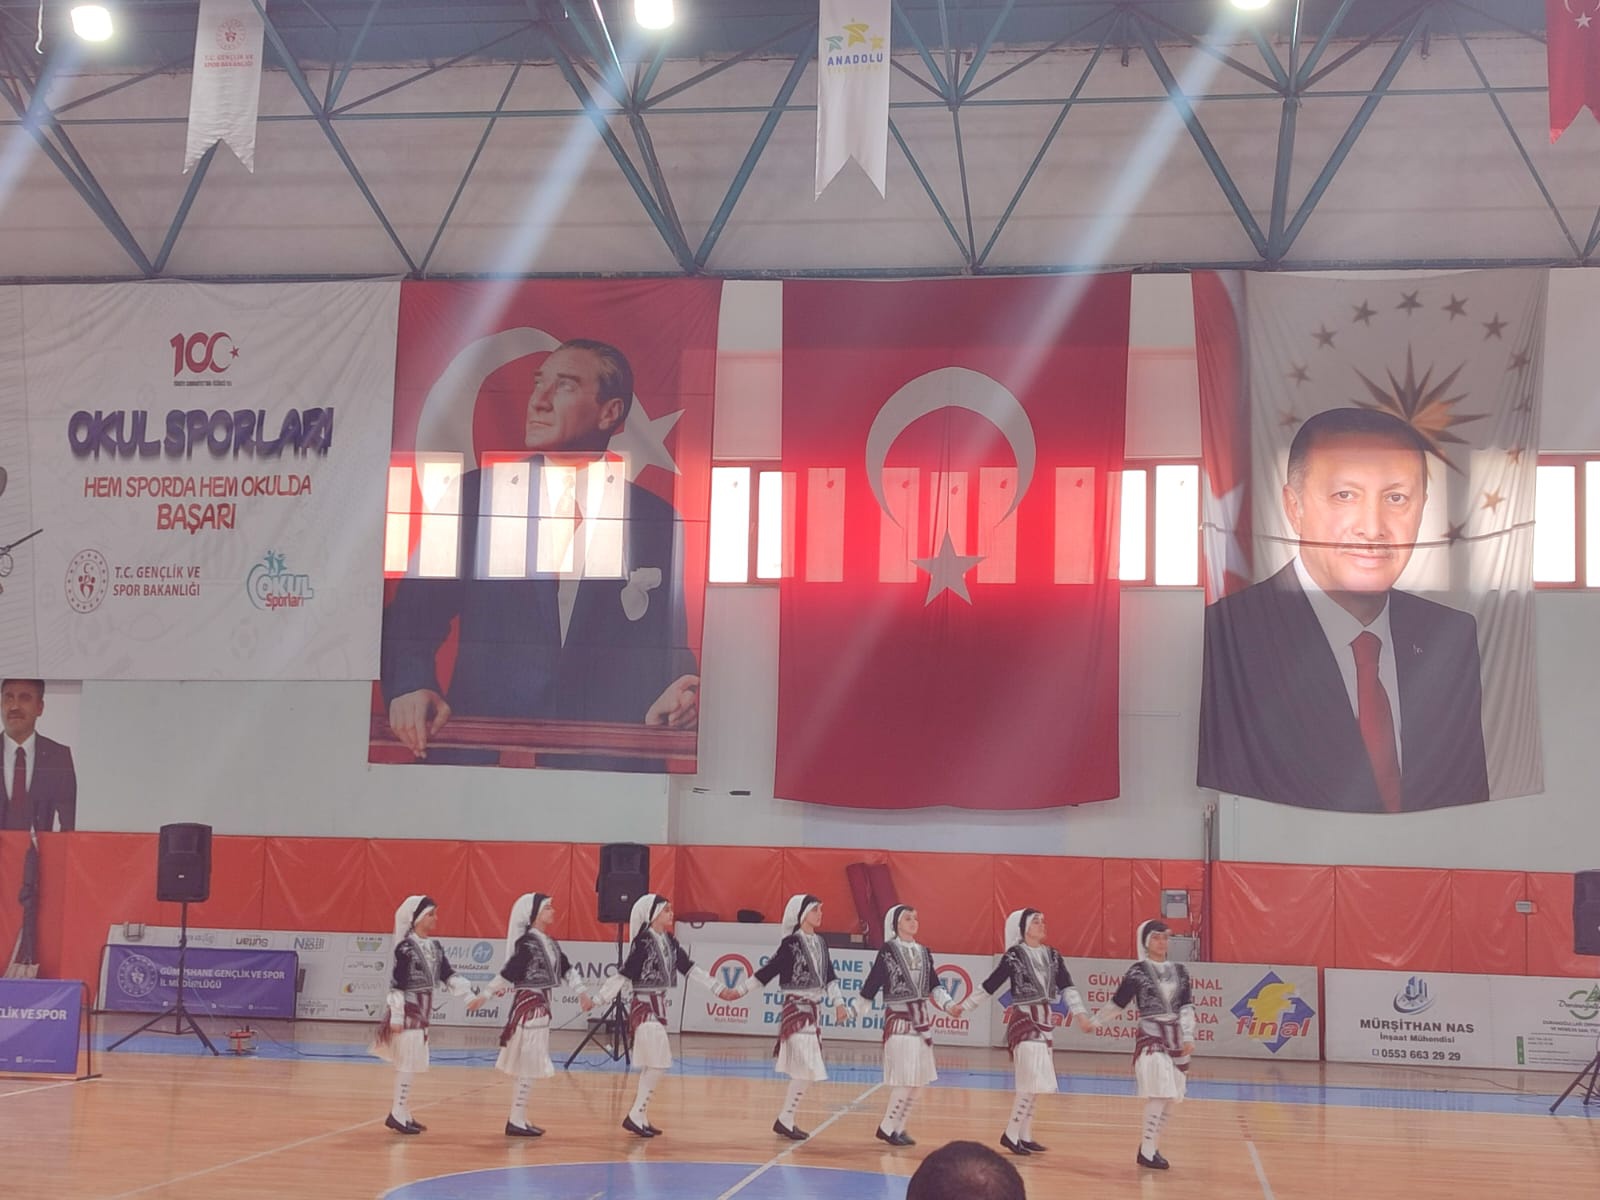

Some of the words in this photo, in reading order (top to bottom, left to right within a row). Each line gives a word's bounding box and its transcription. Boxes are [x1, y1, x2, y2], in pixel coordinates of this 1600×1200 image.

[827, 53, 883, 66] ANADOLU
[68, 410, 161, 459] OKUL
[163, 407, 335, 459] SPORLARI
[84, 477, 122, 498] HEM
[126, 476, 197, 498] SPORDA
[200, 476, 238, 497] HEM
[241, 475, 312, 496] OKULDA
[157, 503, 237, 534] BAŞARI
[115, 566, 134, 579] T.C.
[137, 565, 185, 583] GENÇLİK
[187, 566, 201, 579] VE
[113, 584, 141, 597] SPOR
[144, 581, 201, 597] BAKANLIĞI
[257, 574, 313, 600] OKUL
[214, 969, 250, 981] GENÇLİK
[251, 970, 262, 979] VE
[263, 971, 285, 980] SPOR
[169, 978, 222, 989] MDÜRLÜĞÜ
[1191, 976, 1222, 991] İNAL
[20, 1008, 35, 1019] VE
[36, 1009, 67, 1020] SPOR
[466, 1006, 498, 1018] mavi
[706, 1003, 749, 1018] Vatan
[1235, 1017, 1312, 1037] final
[1360, 1018, 1442, 1032] MÜRŞİTHAN
[1446, 1023, 1474, 1033] NAS
[1380, 1032, 1407, 1042] İnşaat
[1410, 1034, 1455, 1043] Mühendisi
[1381, 1048, 1407, 1058] 0553
[1410, 1050, 1429, 1059] 663
[1432, 1051, 1445, 1060] 29
[1448, 1052, 1461, 1061] 29
